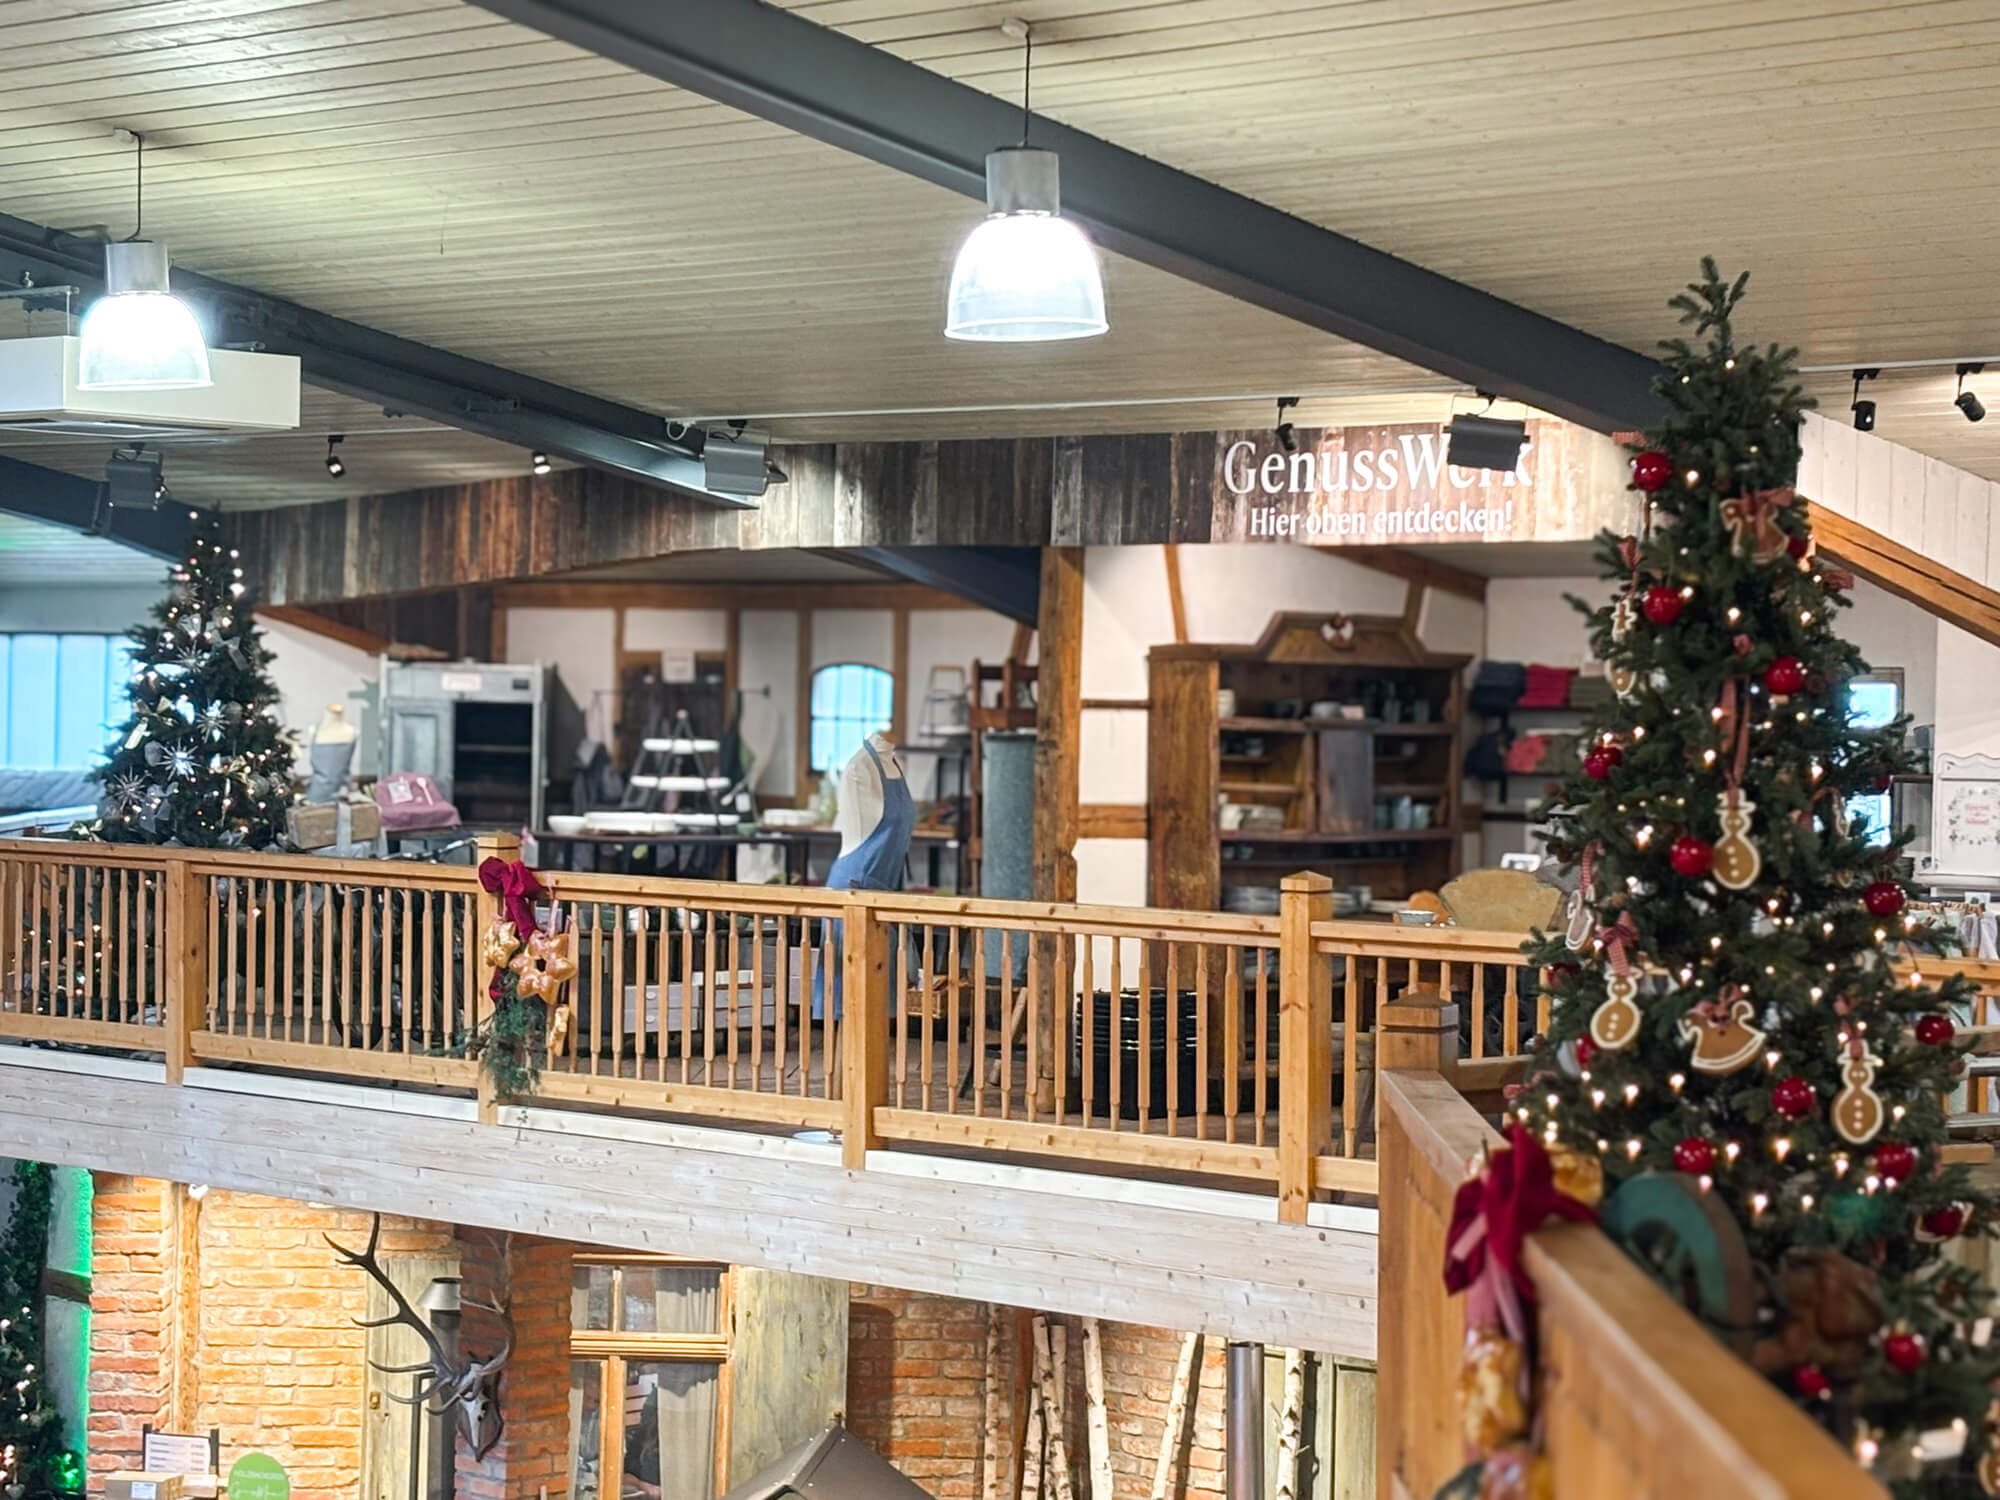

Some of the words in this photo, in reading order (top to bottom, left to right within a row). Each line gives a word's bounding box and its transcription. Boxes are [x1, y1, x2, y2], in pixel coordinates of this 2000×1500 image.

[1250, 507, 1300, 536] Hier
[1306, 505, 1365, 535] oben
[1372, 501, 1512, 534] entdecken!
